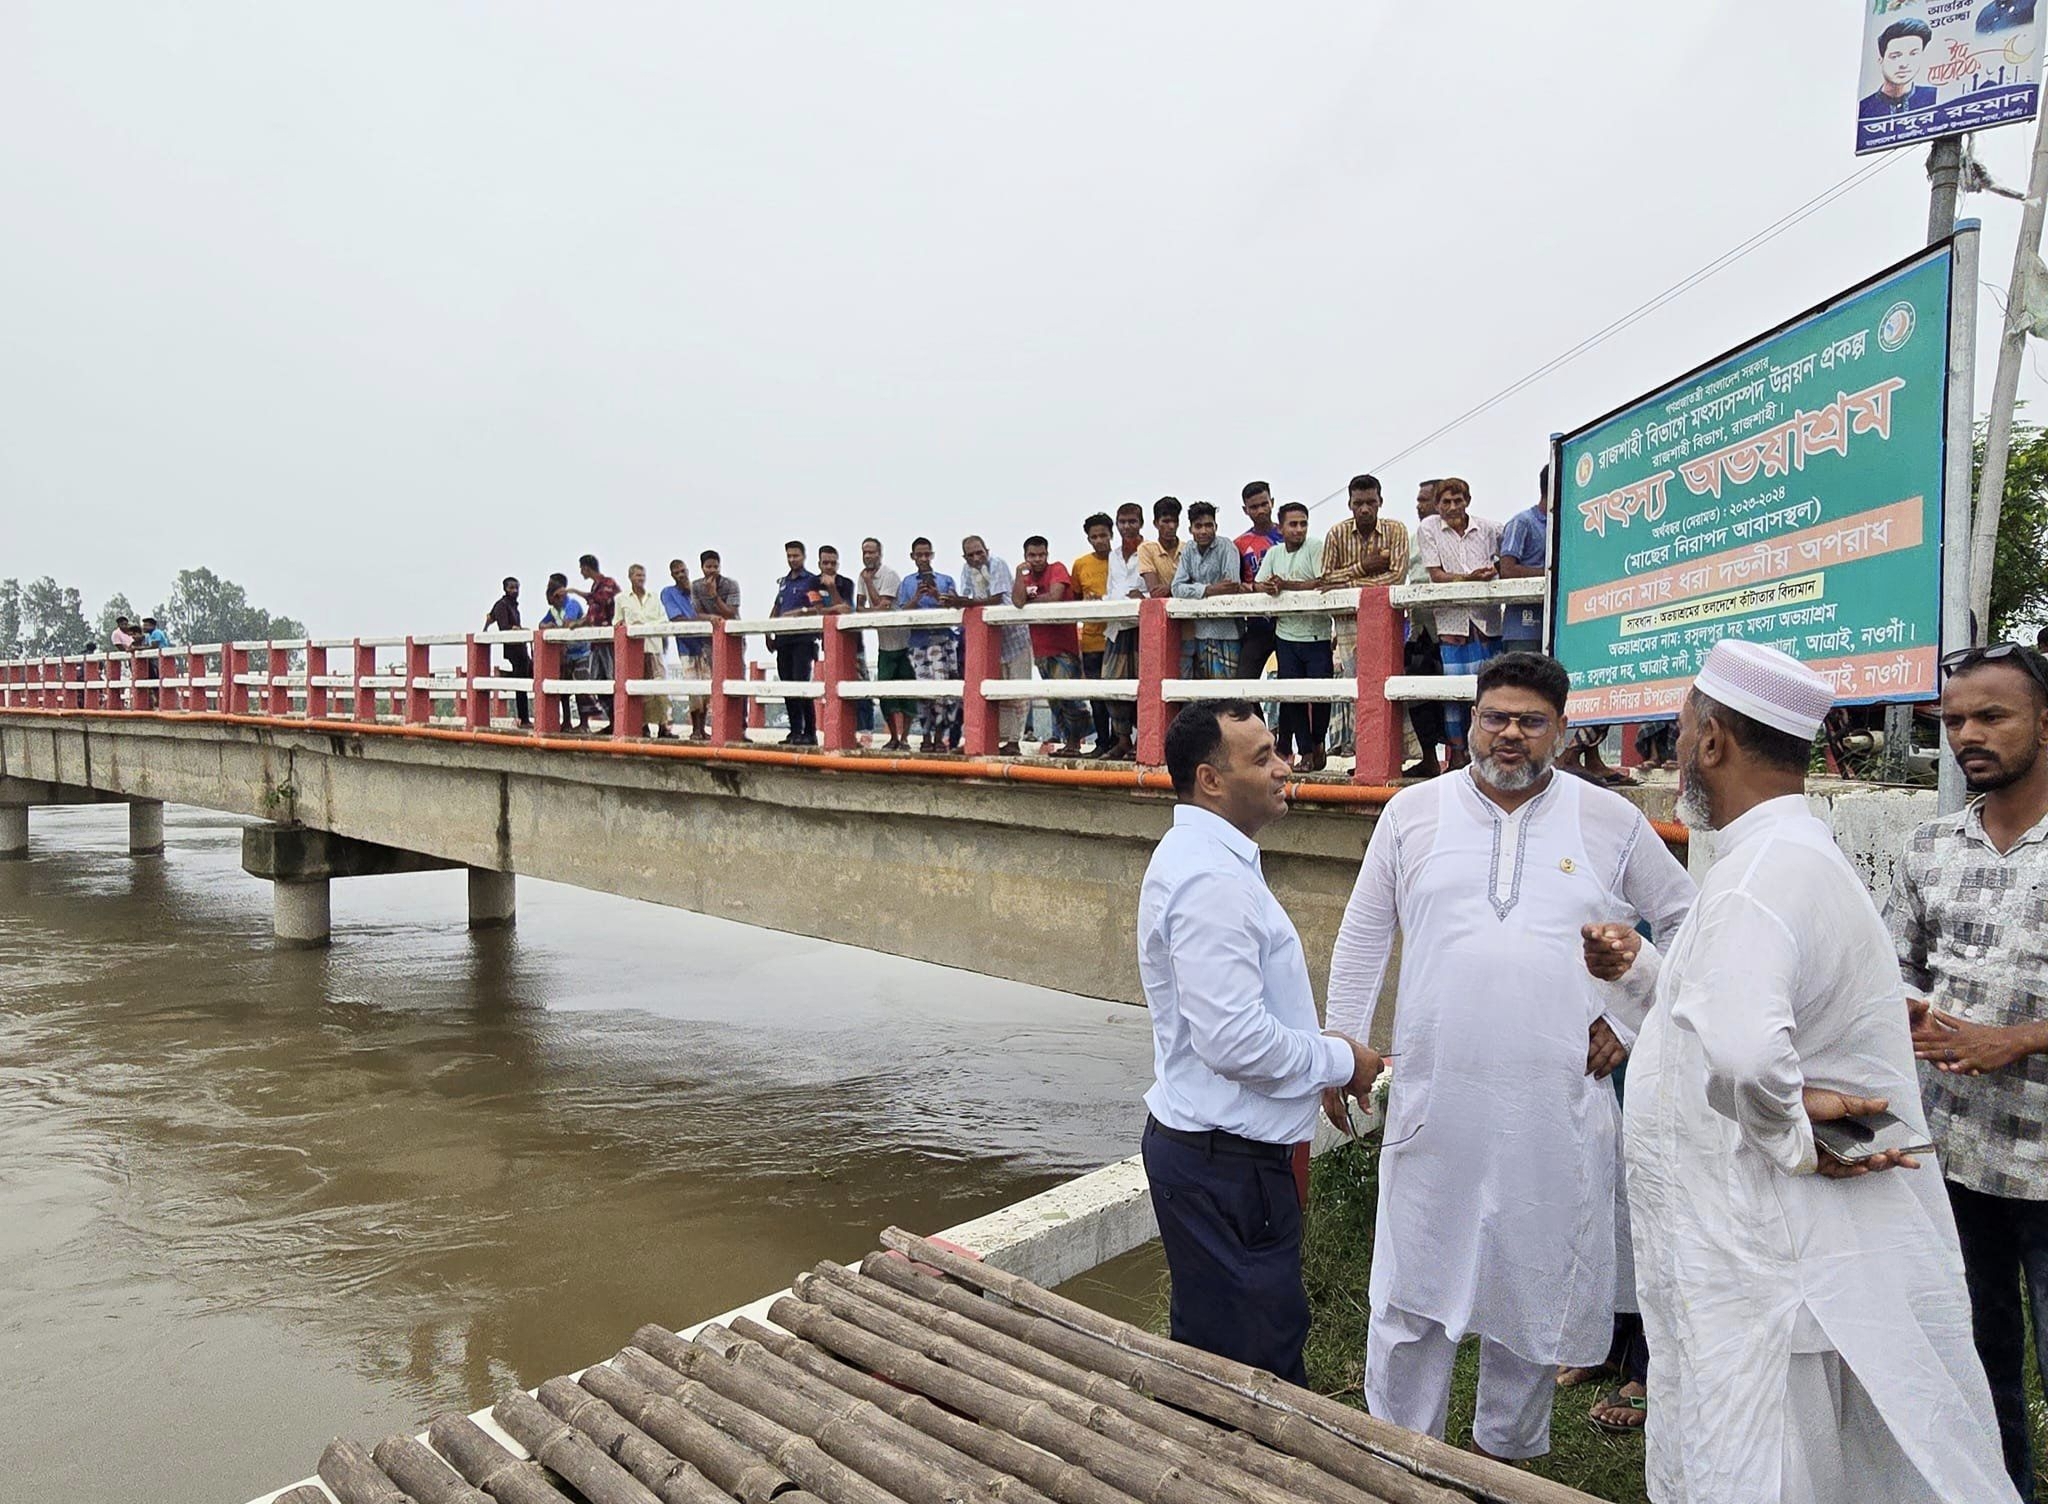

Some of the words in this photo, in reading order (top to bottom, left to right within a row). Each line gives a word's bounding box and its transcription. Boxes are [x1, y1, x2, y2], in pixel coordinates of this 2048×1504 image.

[1943, 89, 2035, 118] রহমান
[1598, 428, 1644, 469] রাজশাহী
[1645, 411, 1688, 450] বিভাগে
[1690, 378, 1766, 429] মৎস্যসম্পদ
[1768, 353, 1817, 393] উন্নয়ন
[1820, 329, 1870, 369] প্রকল্প
[1705, 371, 1740, 395] বাংলাদেশ
[1741, 356, 1769, 378] সরকার
[1578, 470, 1675, 538] মৎস্য
[1679, 376, 1906, 500] অভয়াশ্রম
[1652, 440, 1691, 468] রাজশাহী
[1692, 425, 1728, 451] বিভাগ,
[1624, 544, 1670, 575] (মাছের
[1674, 527, 1729, 558] নিরাপদ
[1732, 496, 1821, 539] আবাসস্থল)
[1652, 521, 1680, 539] অর্থবছর
[1683, 507, 1720, 534] (মেরামত)
[1729, 485, 1786, 518] ২০২৩-২০২৪
[1584, 585, 1634, 613] এখানে
[1640, 576, 1673, 603] মাছ
[1679, 567, 1712, 593] ধরা
[1798, 519, 1893, 562] অপরাধ
[1627, 615, 1652, 630] সাবধান
[1659, 604, 1700, 623] অভয়াশ্রমের
[1702, 596, 1737, 615] তলদেশে
[1739, 585, 1775, 608] কাঁটাতার
[1778, 579, 1816, 600] বিদ্যমান
[1608, 635, 1658, 658] অভয়াশ্রমের
[1684, 622, 1724, 645] রসুলপুর
[1727, 619, 1745, 638] দহ
[1747, 614, 1776, 634] মৎস্য
[1778, 603, 1838, 628] অভয়াশ্রম
[1805, 626, 1856, 653] আত্রাই,
[1587, 665, 1618, 686] রসুলপুর
[1620, 663, 1637, 681] দহ,
[1639, 655, 1670, 676] আত্রাই
[1671, 649, 1692, 673] নদী,
[1609, 688, 1641, 711] সিনিয়র
[1643, 686, 1686, 707] উপজেলা
